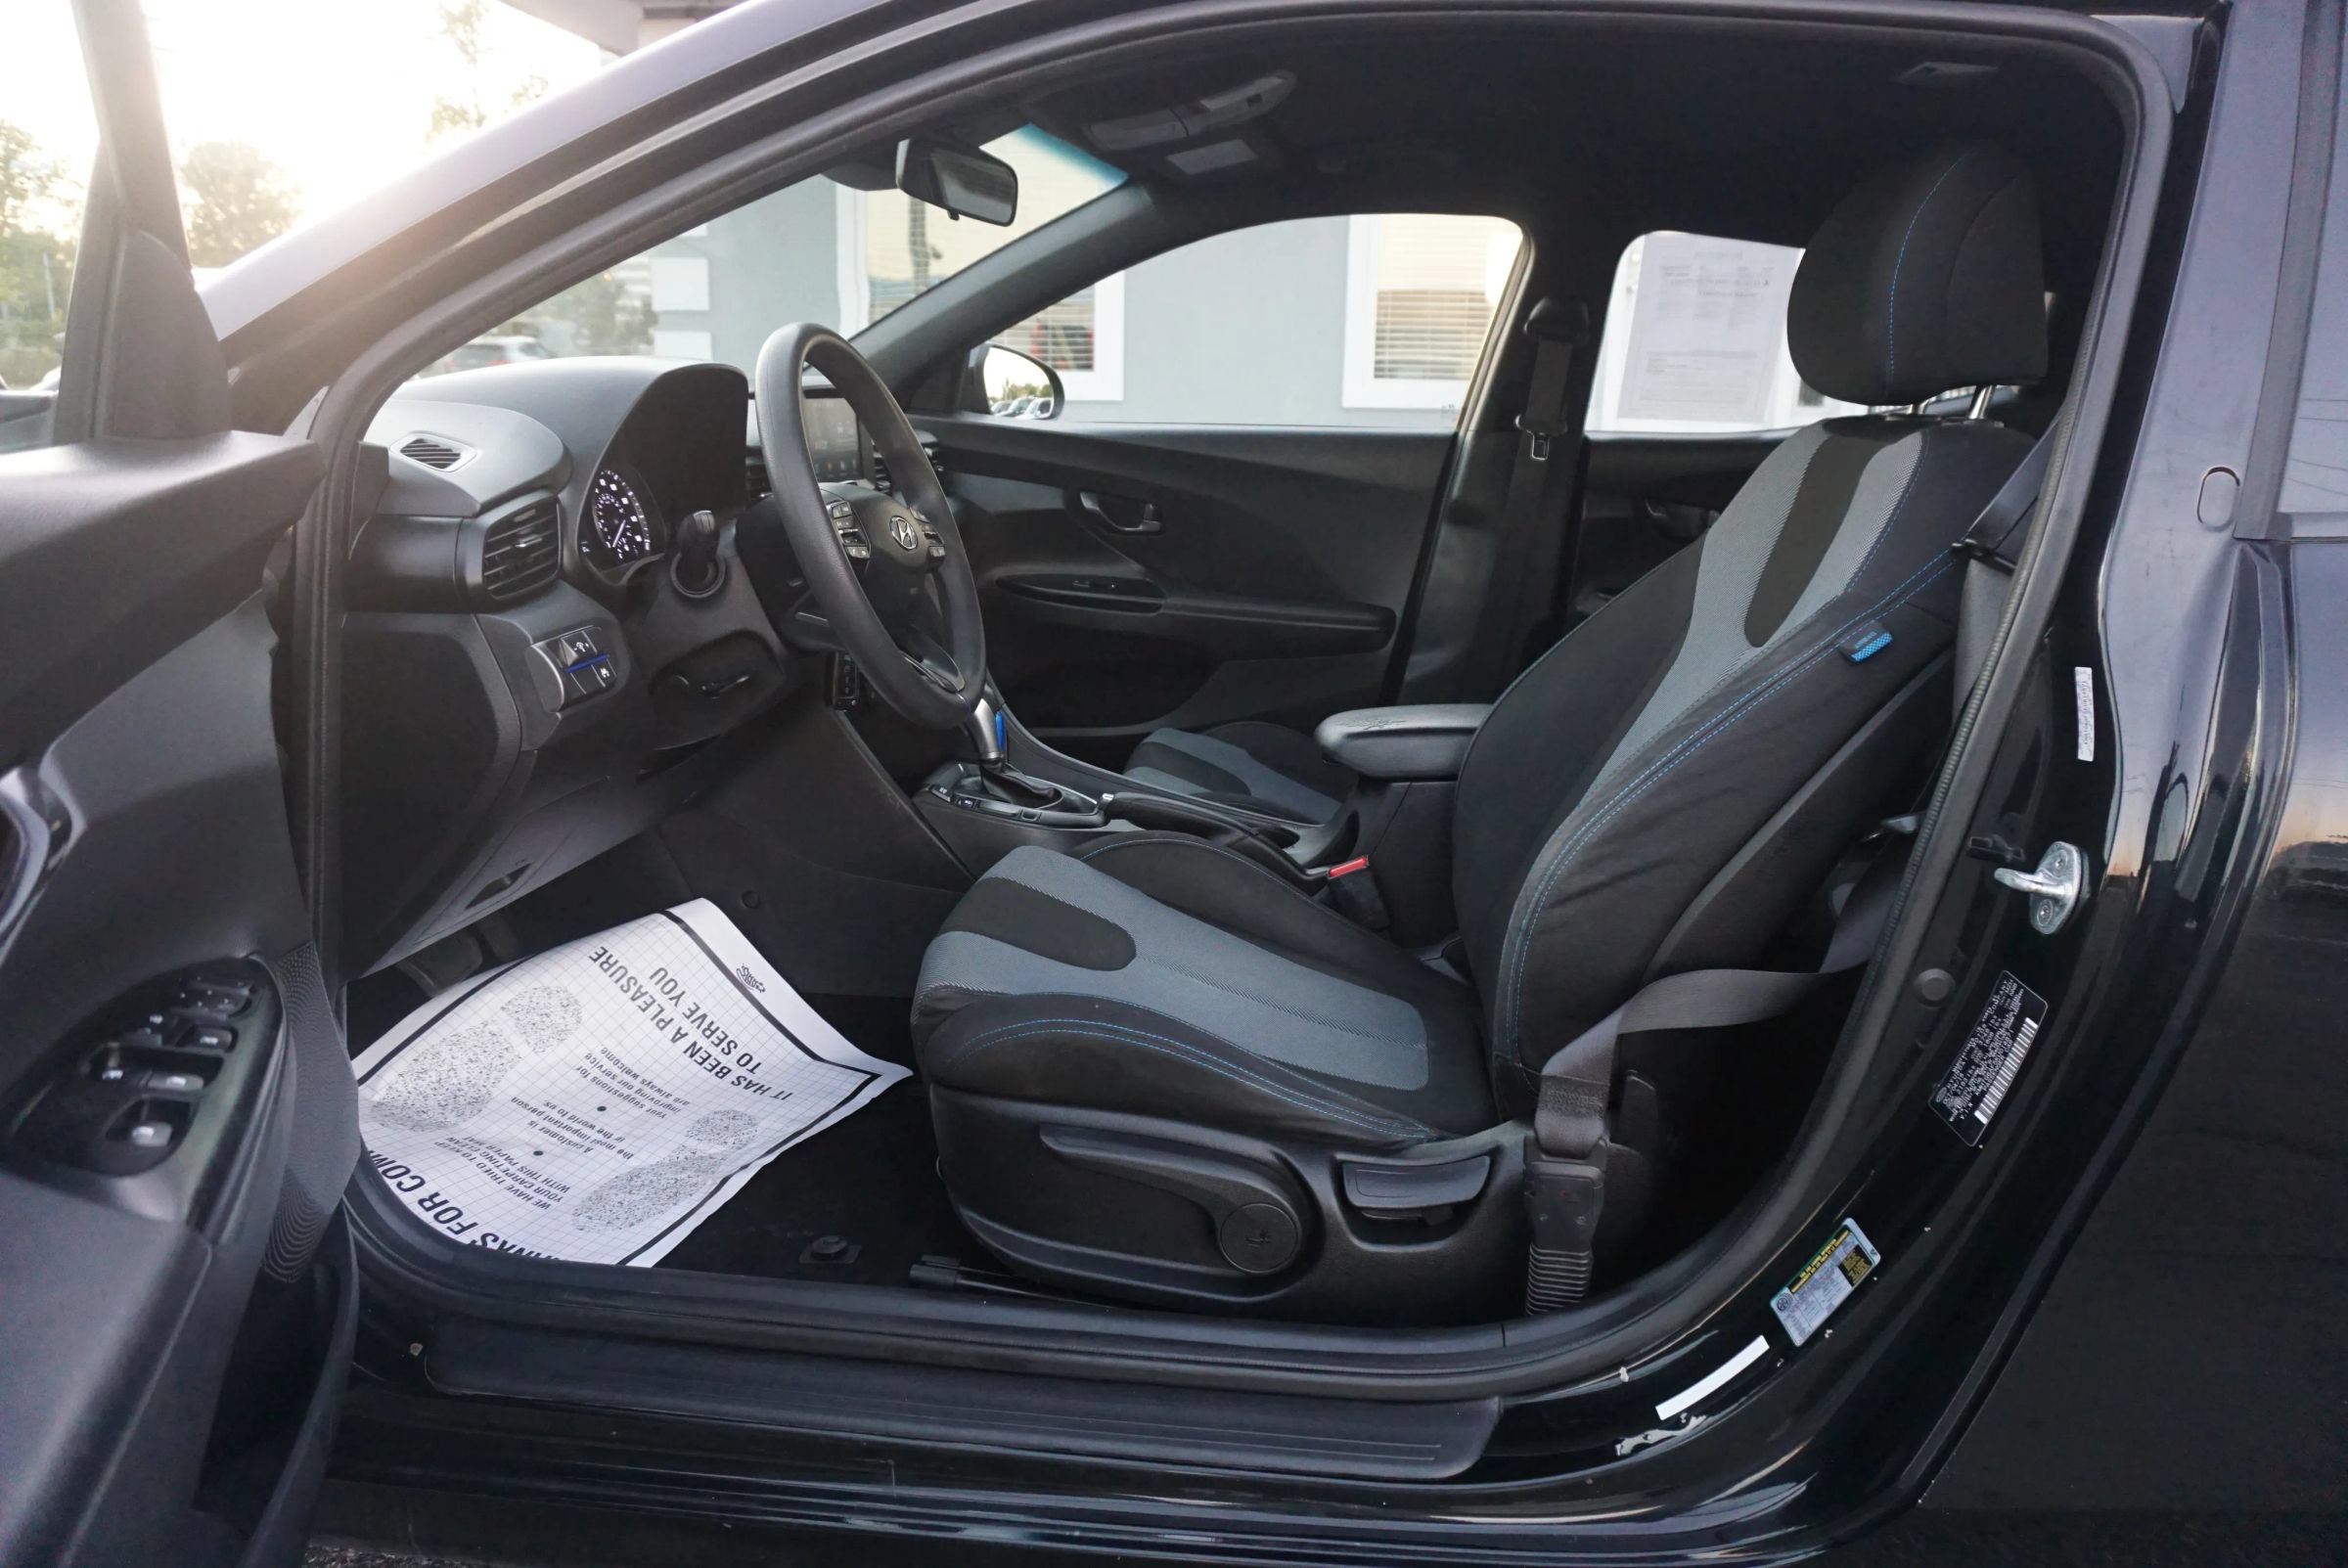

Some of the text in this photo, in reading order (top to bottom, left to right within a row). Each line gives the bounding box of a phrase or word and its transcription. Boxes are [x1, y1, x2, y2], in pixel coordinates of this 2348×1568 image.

[589, 946, 792, 1101] IT HAS BEEN A PLEASURE
[650, 967, 762, 1074] TO SERVE YOU
[575, 1065, 591, 1079] for
[585, 1053, 681, 1113] improving our service
[640, 1078, 672, 1098] always
[590, 1077, 646, 1108] suggestions
[673, 1097, 690, 1106] are
[511, 1097, 634, 1159] the most important person
[557, 1108, 568, 1117] to
[567, 1115, 596, 1130] world
[539, 1127, 585, 1148] customer
[597, 1128, 614, 1139] the
[434, 1142, 552, 1210] WE HAVE TRIED TO KEEP
[446, 1137, 564, 1202] YOUR CARPETING CLEAN
[462, 1137, 570, 1193] WITH THIS PAPER MAT
[418, 1191, 478, 1235] FOR
